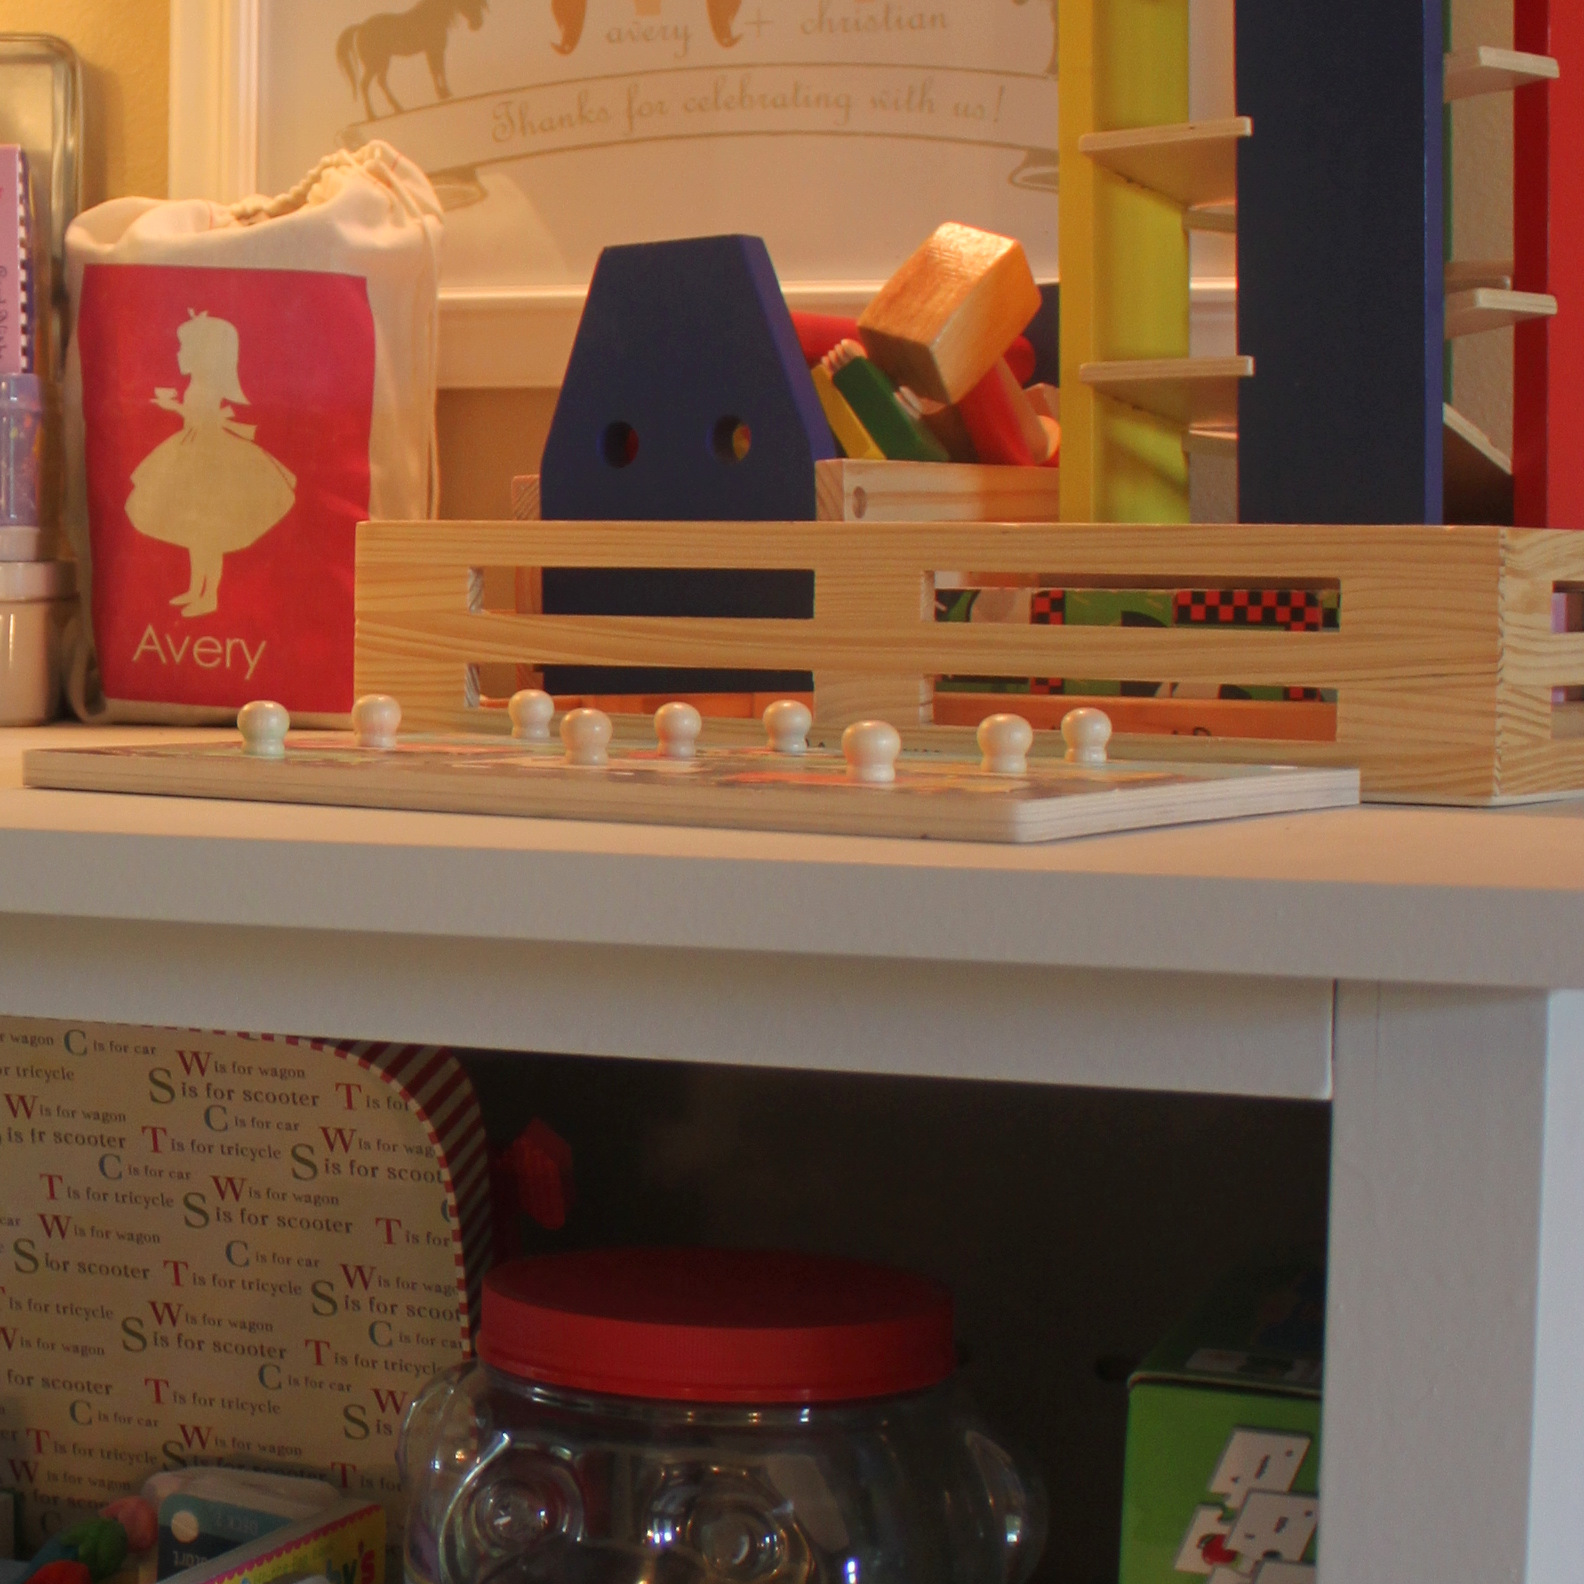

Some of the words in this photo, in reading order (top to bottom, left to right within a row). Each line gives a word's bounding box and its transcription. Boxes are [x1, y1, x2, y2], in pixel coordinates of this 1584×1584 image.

[605, 19, 693, 58] avery
[491, 89, 610, 143] Thanks
[624, 83, 667, 133] for
[682, 73, 852, 126] celebrating
[869, 77, 935, 115] with
[953, 84, 1007, 123] us!
[132, 623, 266, 681] Avery
[175, 1050, 213, 1077] W
[231, 1062, 254, 1076] for
[258, 1067, 306, 1081] wagon
[148, 1068, 176, 1104] S
[181, 1082, 198, 1098] is
[206, 1083, 234, 1101] for
[243, 1089, 319, 1107] scooter
